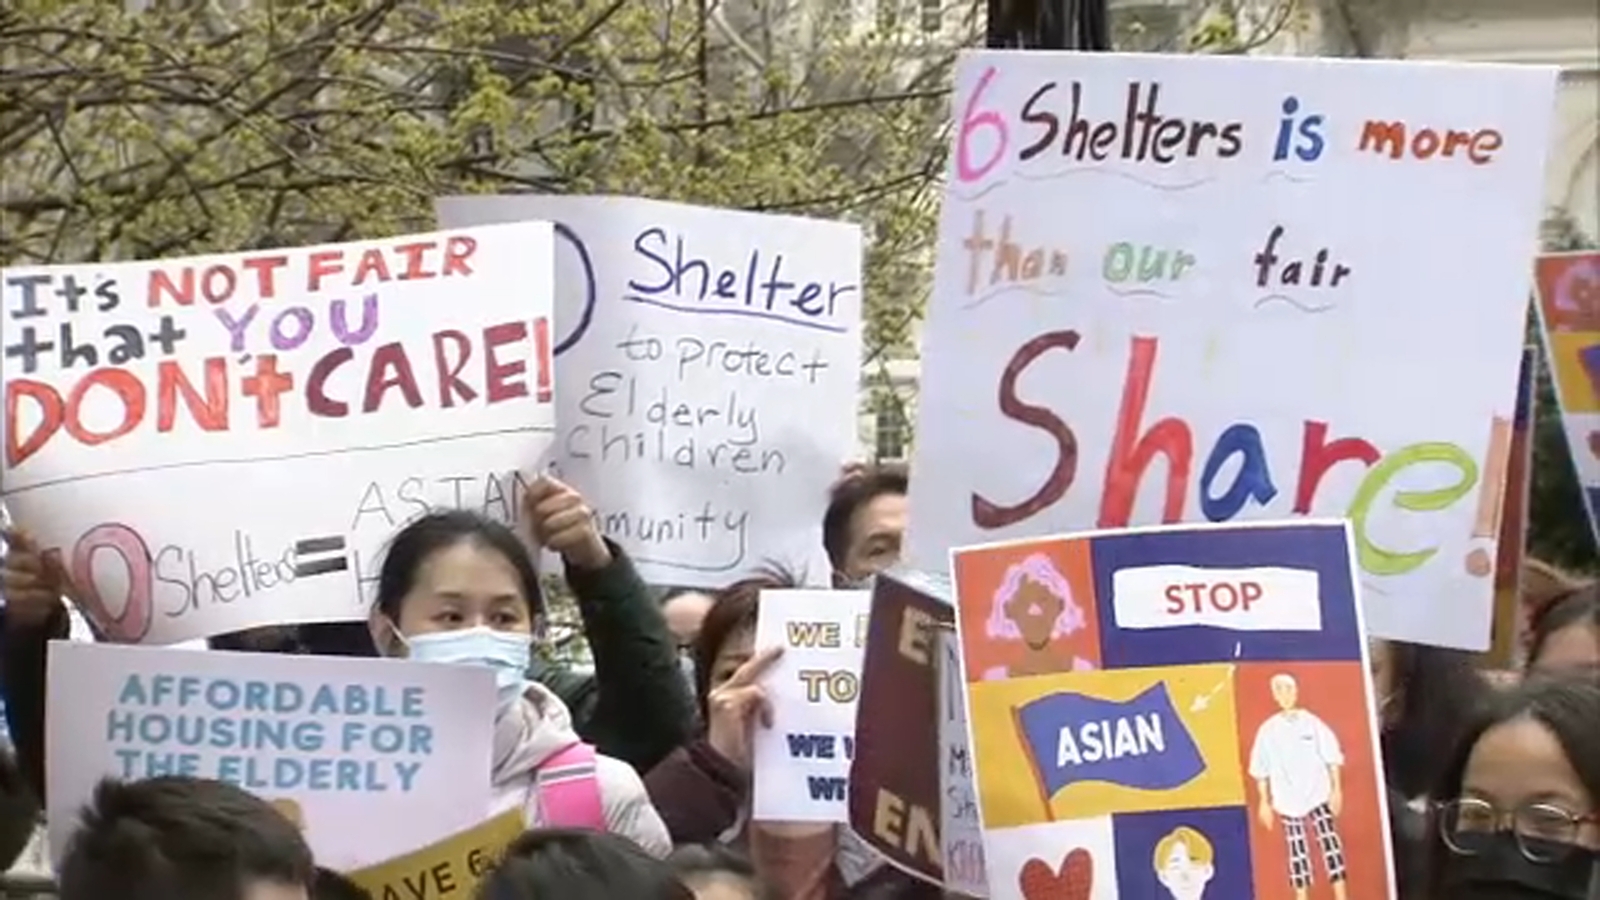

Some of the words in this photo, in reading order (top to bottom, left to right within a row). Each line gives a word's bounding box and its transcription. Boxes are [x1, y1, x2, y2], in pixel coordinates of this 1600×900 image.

[957, 67, 1010, 182] 6
[1019, 82, 1243, 164] Shelters
[1273, 96, 1325, 161] is
[1358, 119, 1503, 165] more
[146, 255, 288, 307] NOT
[307, 235, 478, 292] FAIR
[629, 228, 856, 316] Shelter
[963, 209, 1069, 297] than
[1102, 240, 1196, 284] our
[1254, 226, 1352, 290] fair
[6, 315, 187, 373] that
[213, 293, 379, 353] YOU
[615, 323, 664, 363] to
[678, 336, 830, 383] protect
[305, 317, 552, 418] CARE!
[580, 371, 758, 446] Elderly
[566, 425, 787, 476] Children
[971, 329, 1510, 578] Share!
[591, 502, 752, 544] munity
[154, 530, 300, 618] Shelters
[1164, 582, 1263, 615] STOP
[786, 620, 841, 648] WE
[118, 673, 426, 717] AFFORDABLE
[799, 669, 859, 704] TO
[106, 709, 325, 751] HOUSING
[341, 722, 434, 754] FOR
[786, 733, 836, 759] WE
[1056, 713, 1165, 768] ASIAN
[114, 749, 201, 779] THE
[217, 755, 422, 792] ELDERLY
[382, 862, 456, 900] AVE
